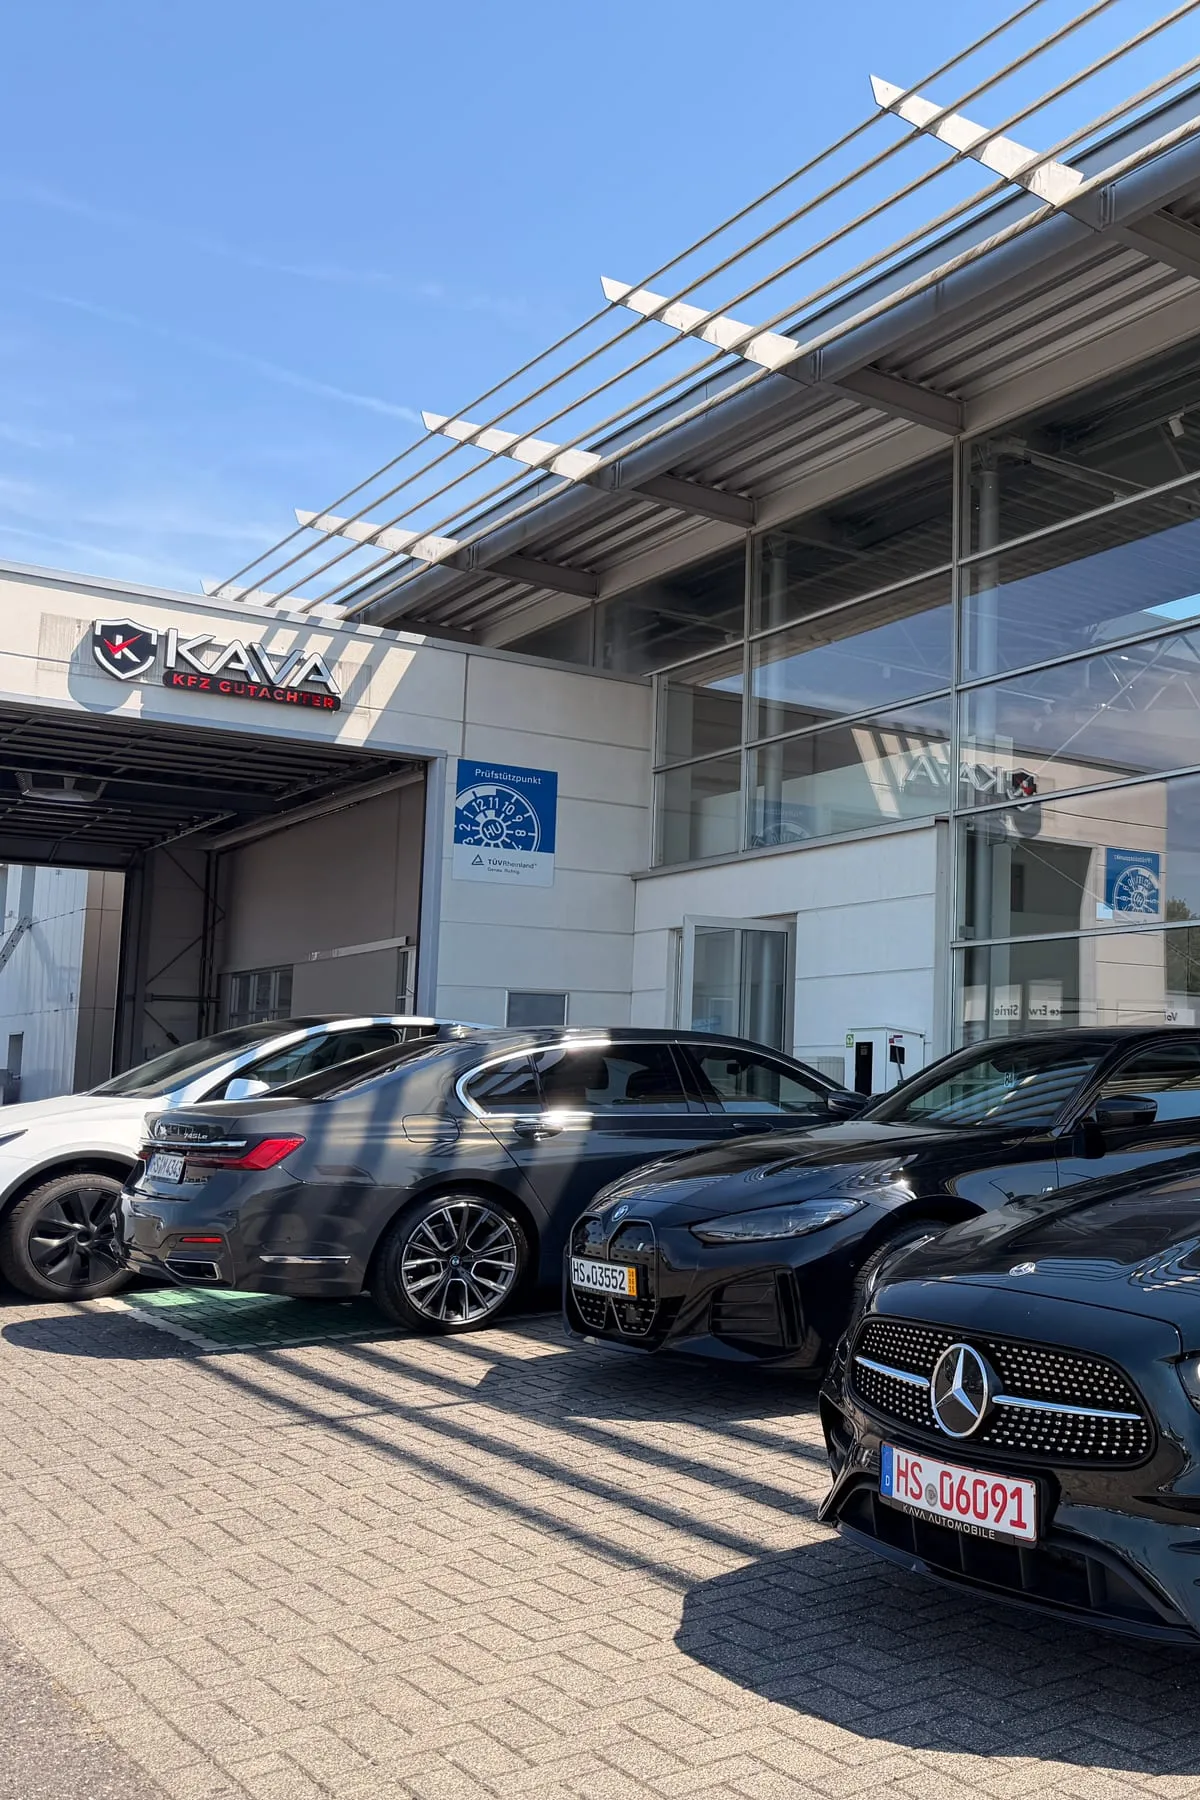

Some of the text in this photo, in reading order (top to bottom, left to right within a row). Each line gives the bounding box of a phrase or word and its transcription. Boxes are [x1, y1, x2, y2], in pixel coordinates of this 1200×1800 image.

[164, 628, 342, 694] KAVA
[172, 673, 334, 708] KFZ GUTACHTER
[475, 768, 541, 784] Prüfstützpunkt
[472, 799, 487, 812] 12
[489, 797, 499, 809] 11
[502, 801, 515, 815] 10
[484, 822, 502, 838] HU
[573, 1260, 585, 1282] HS
[592, 1265, 625, 1291] 03552
[896, 1454, 1027, 1530] HS 06091
[902, 1504, 995, 1540] KAVA AUTOMOBILE
